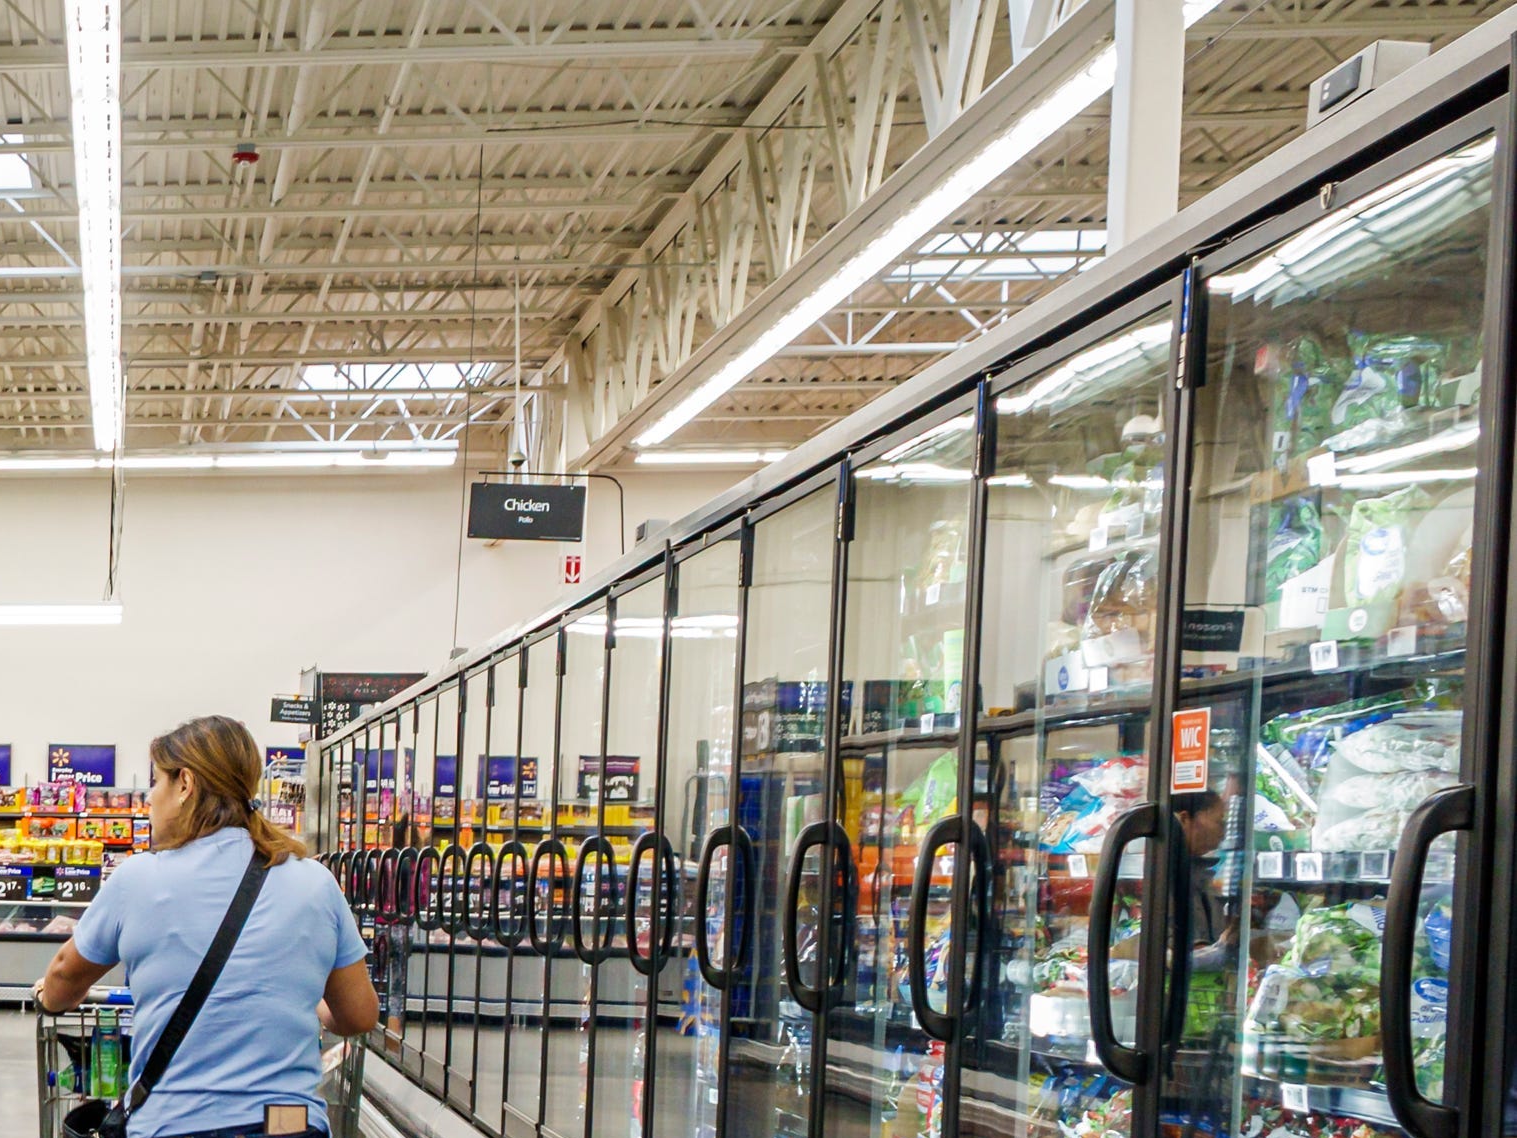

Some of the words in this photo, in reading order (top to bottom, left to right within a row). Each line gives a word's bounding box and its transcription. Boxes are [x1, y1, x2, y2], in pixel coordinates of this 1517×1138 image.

[504, 498, 550, 512] Chicken
[1180, 726, 1202, 749] WIC
[75, 772, 103, 783] Price
